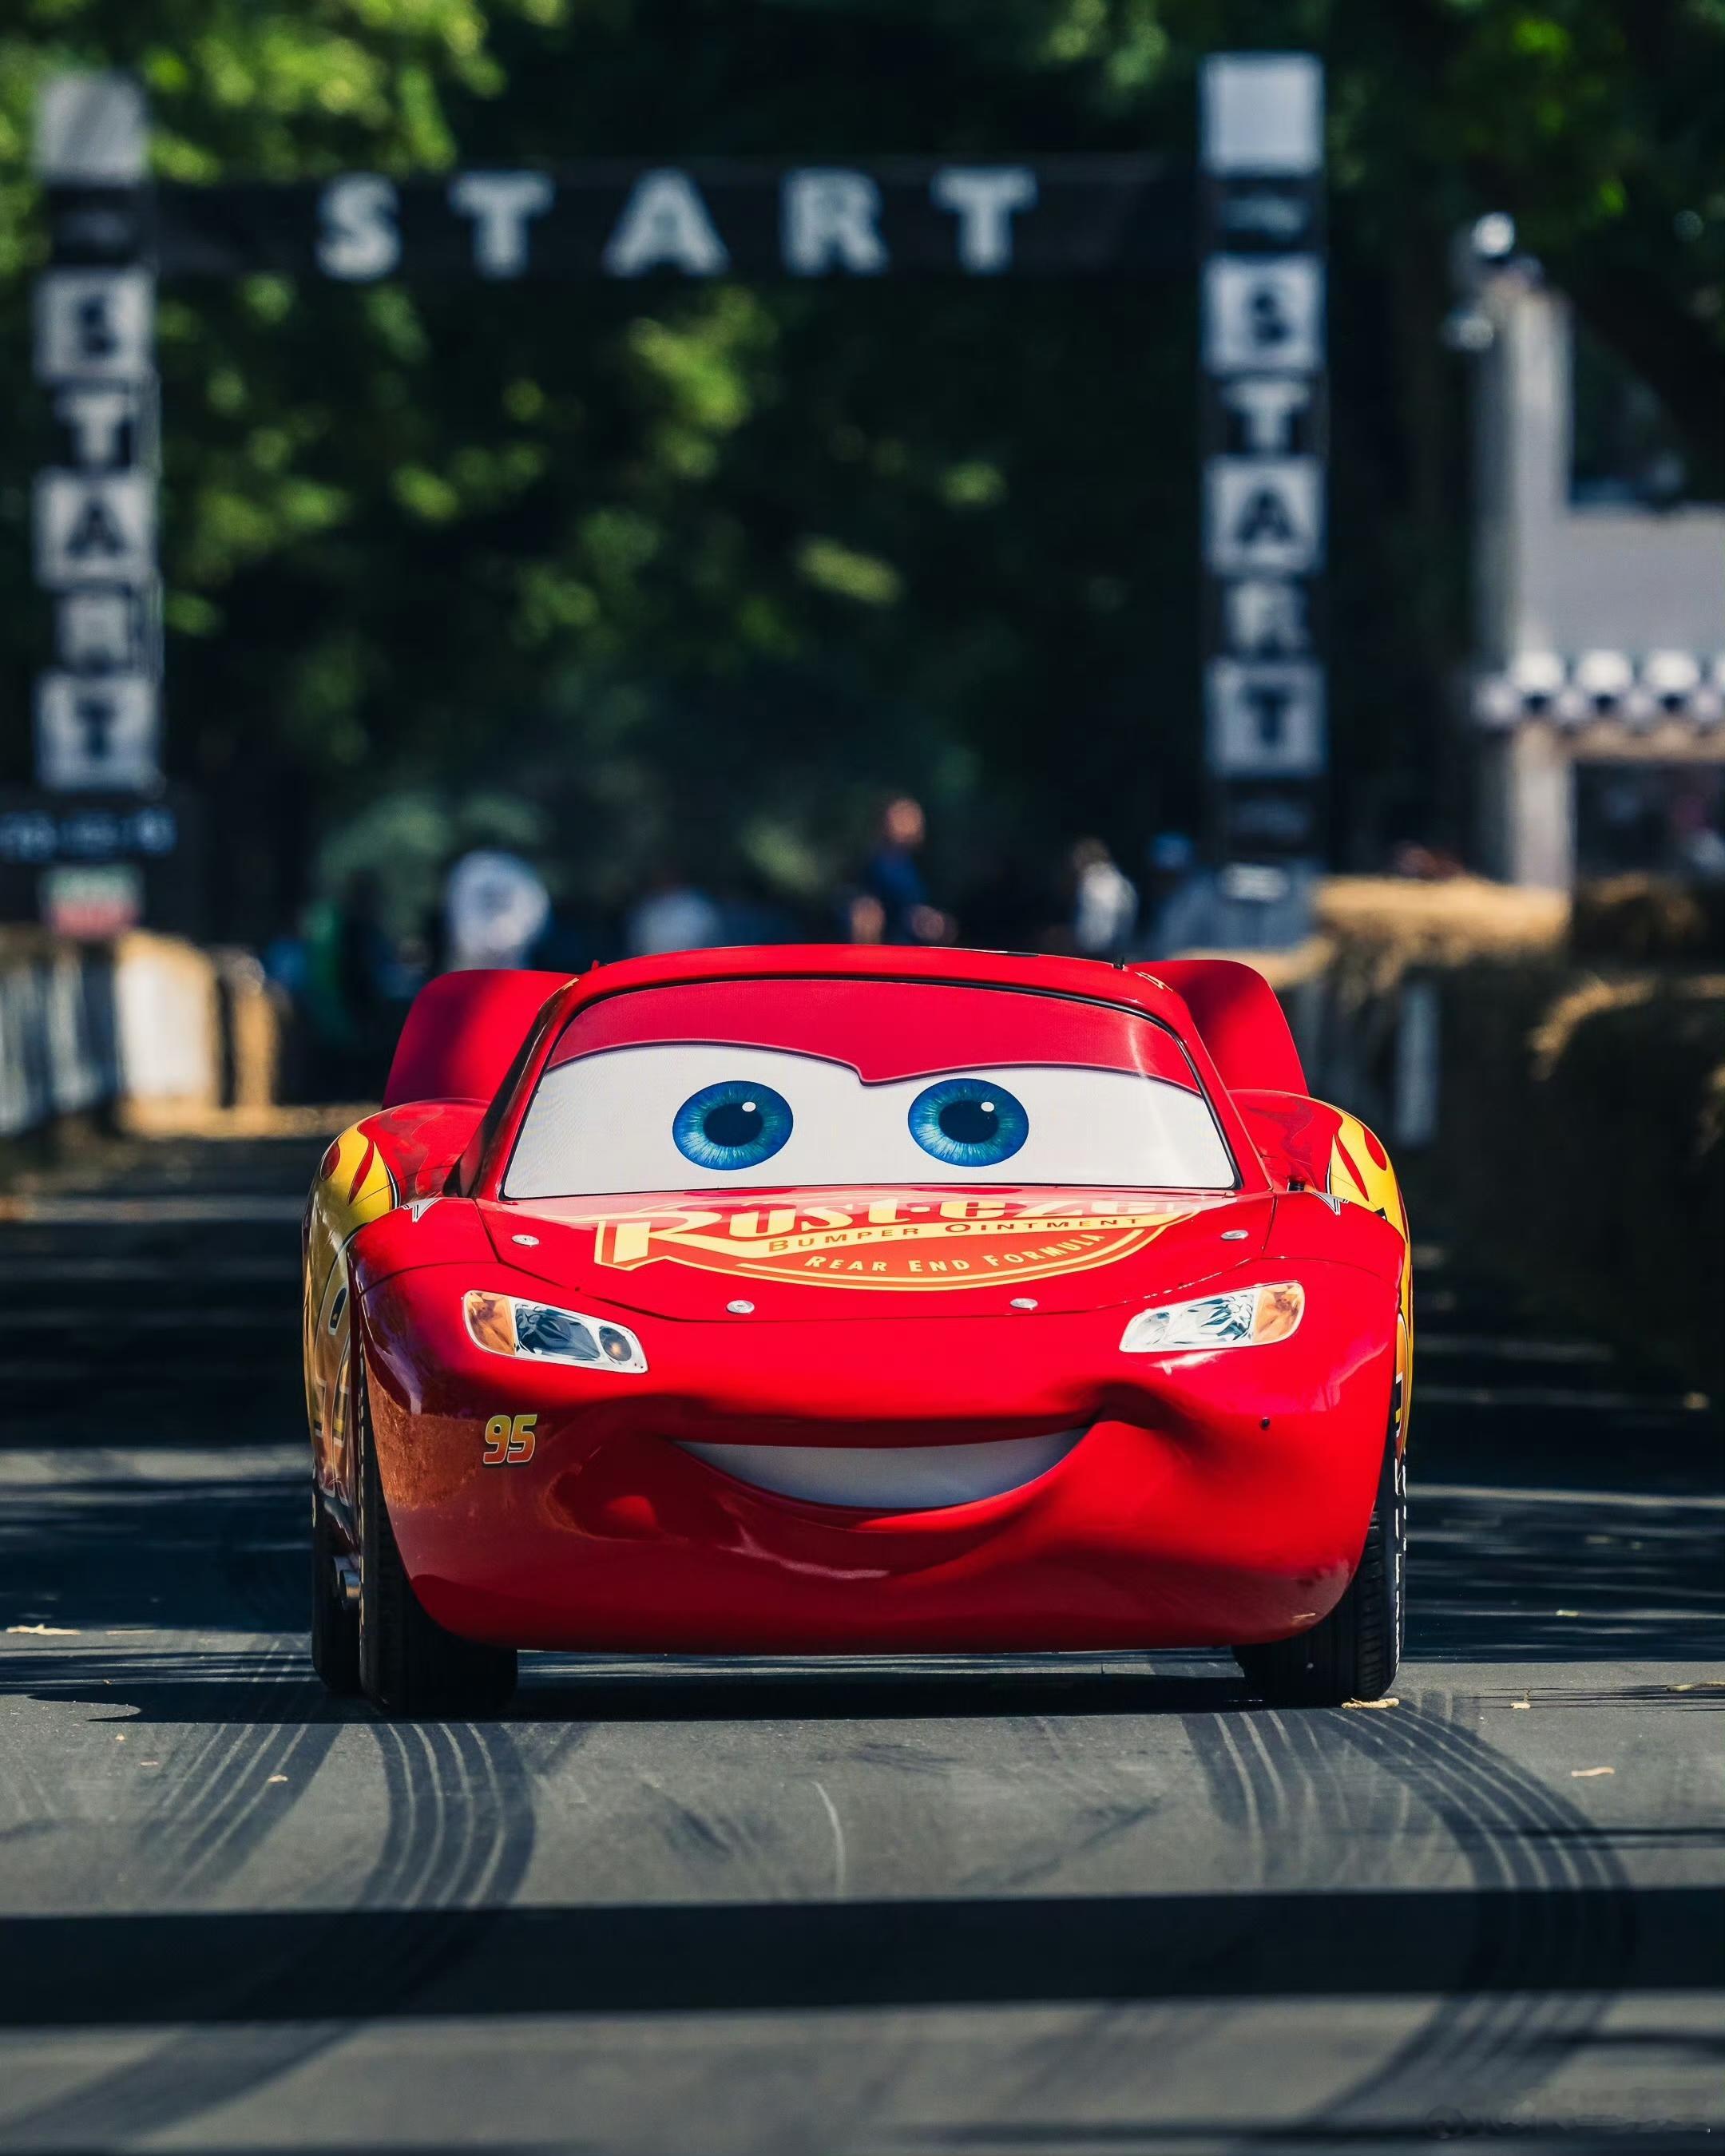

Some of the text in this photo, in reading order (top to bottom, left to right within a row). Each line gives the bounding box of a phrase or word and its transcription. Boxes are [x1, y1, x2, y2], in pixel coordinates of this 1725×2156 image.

[318, 166, 1037, 279] START
[1220, 283, 1311, 751] START
[908, 1258, 970, 1273] END
[482, 1413, 537, 1464] 95
